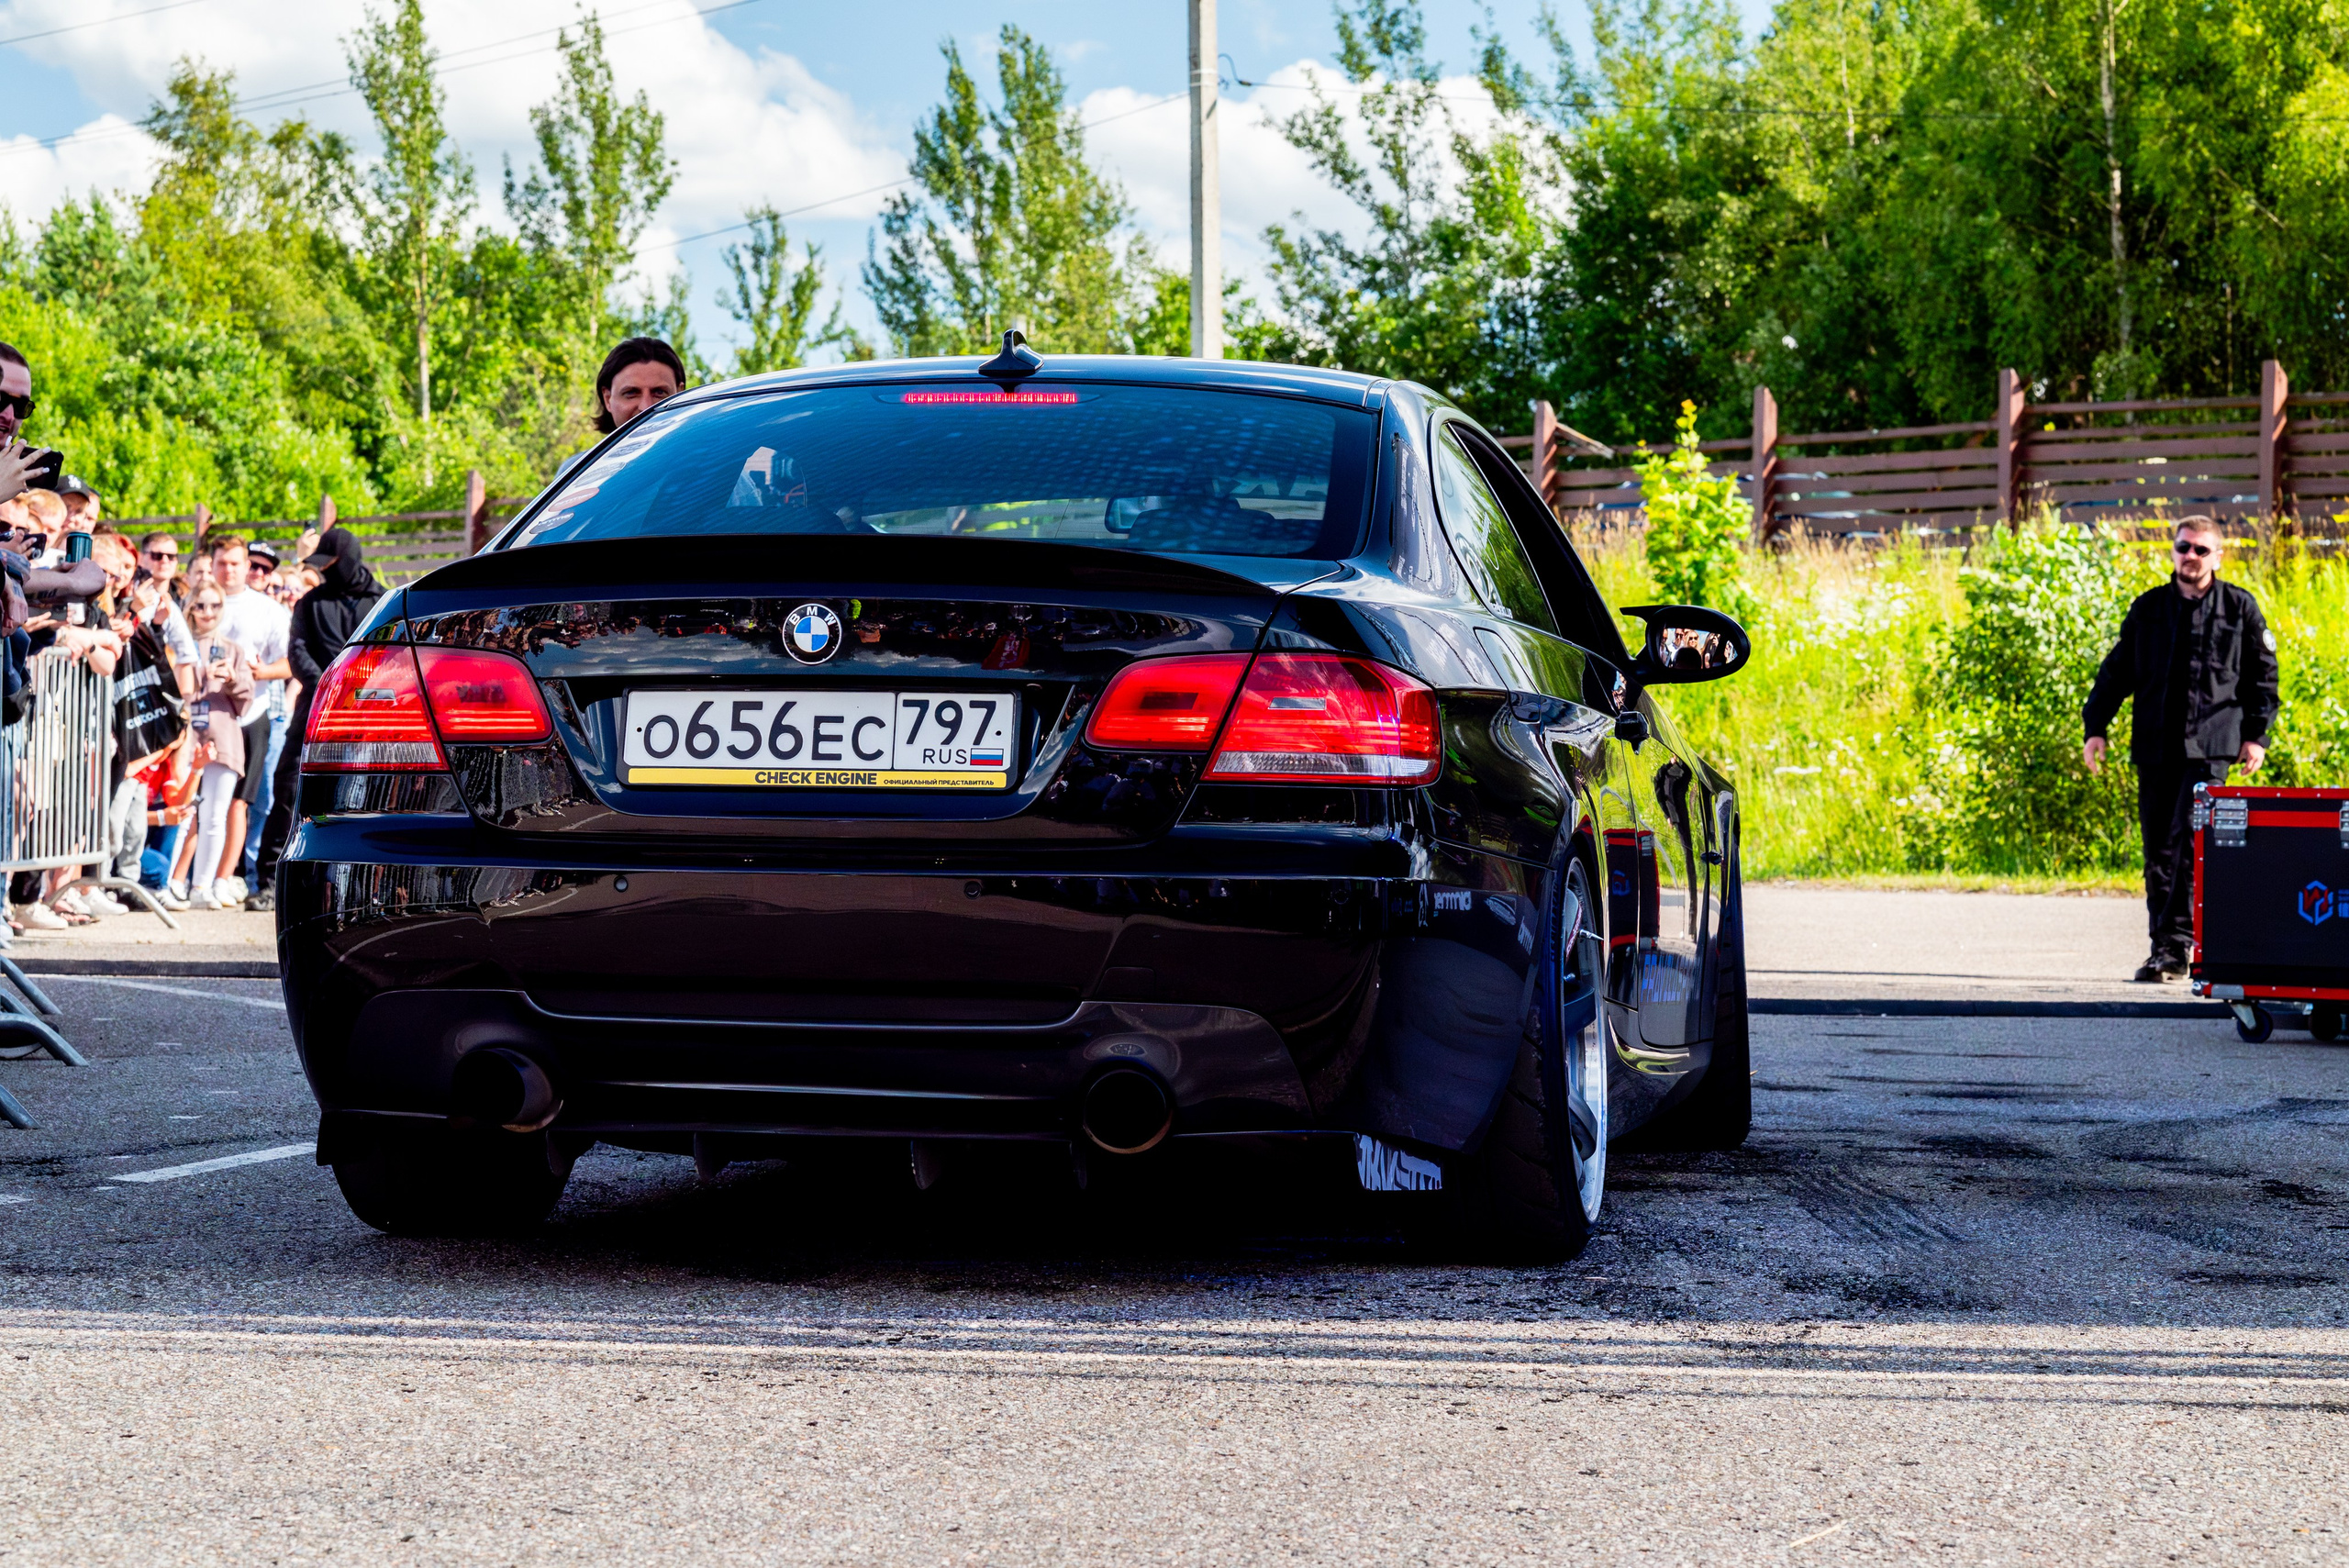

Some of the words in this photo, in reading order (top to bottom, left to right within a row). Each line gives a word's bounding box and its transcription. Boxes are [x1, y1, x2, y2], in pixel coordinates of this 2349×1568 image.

[789, 606, 836, 626] BMW
[902, 699, 997, 745] 797
[922, 749, 967, 764] RUS
[754, 772, 812, 784] CHECK
[815, 773, 877, 785] ENGINE
